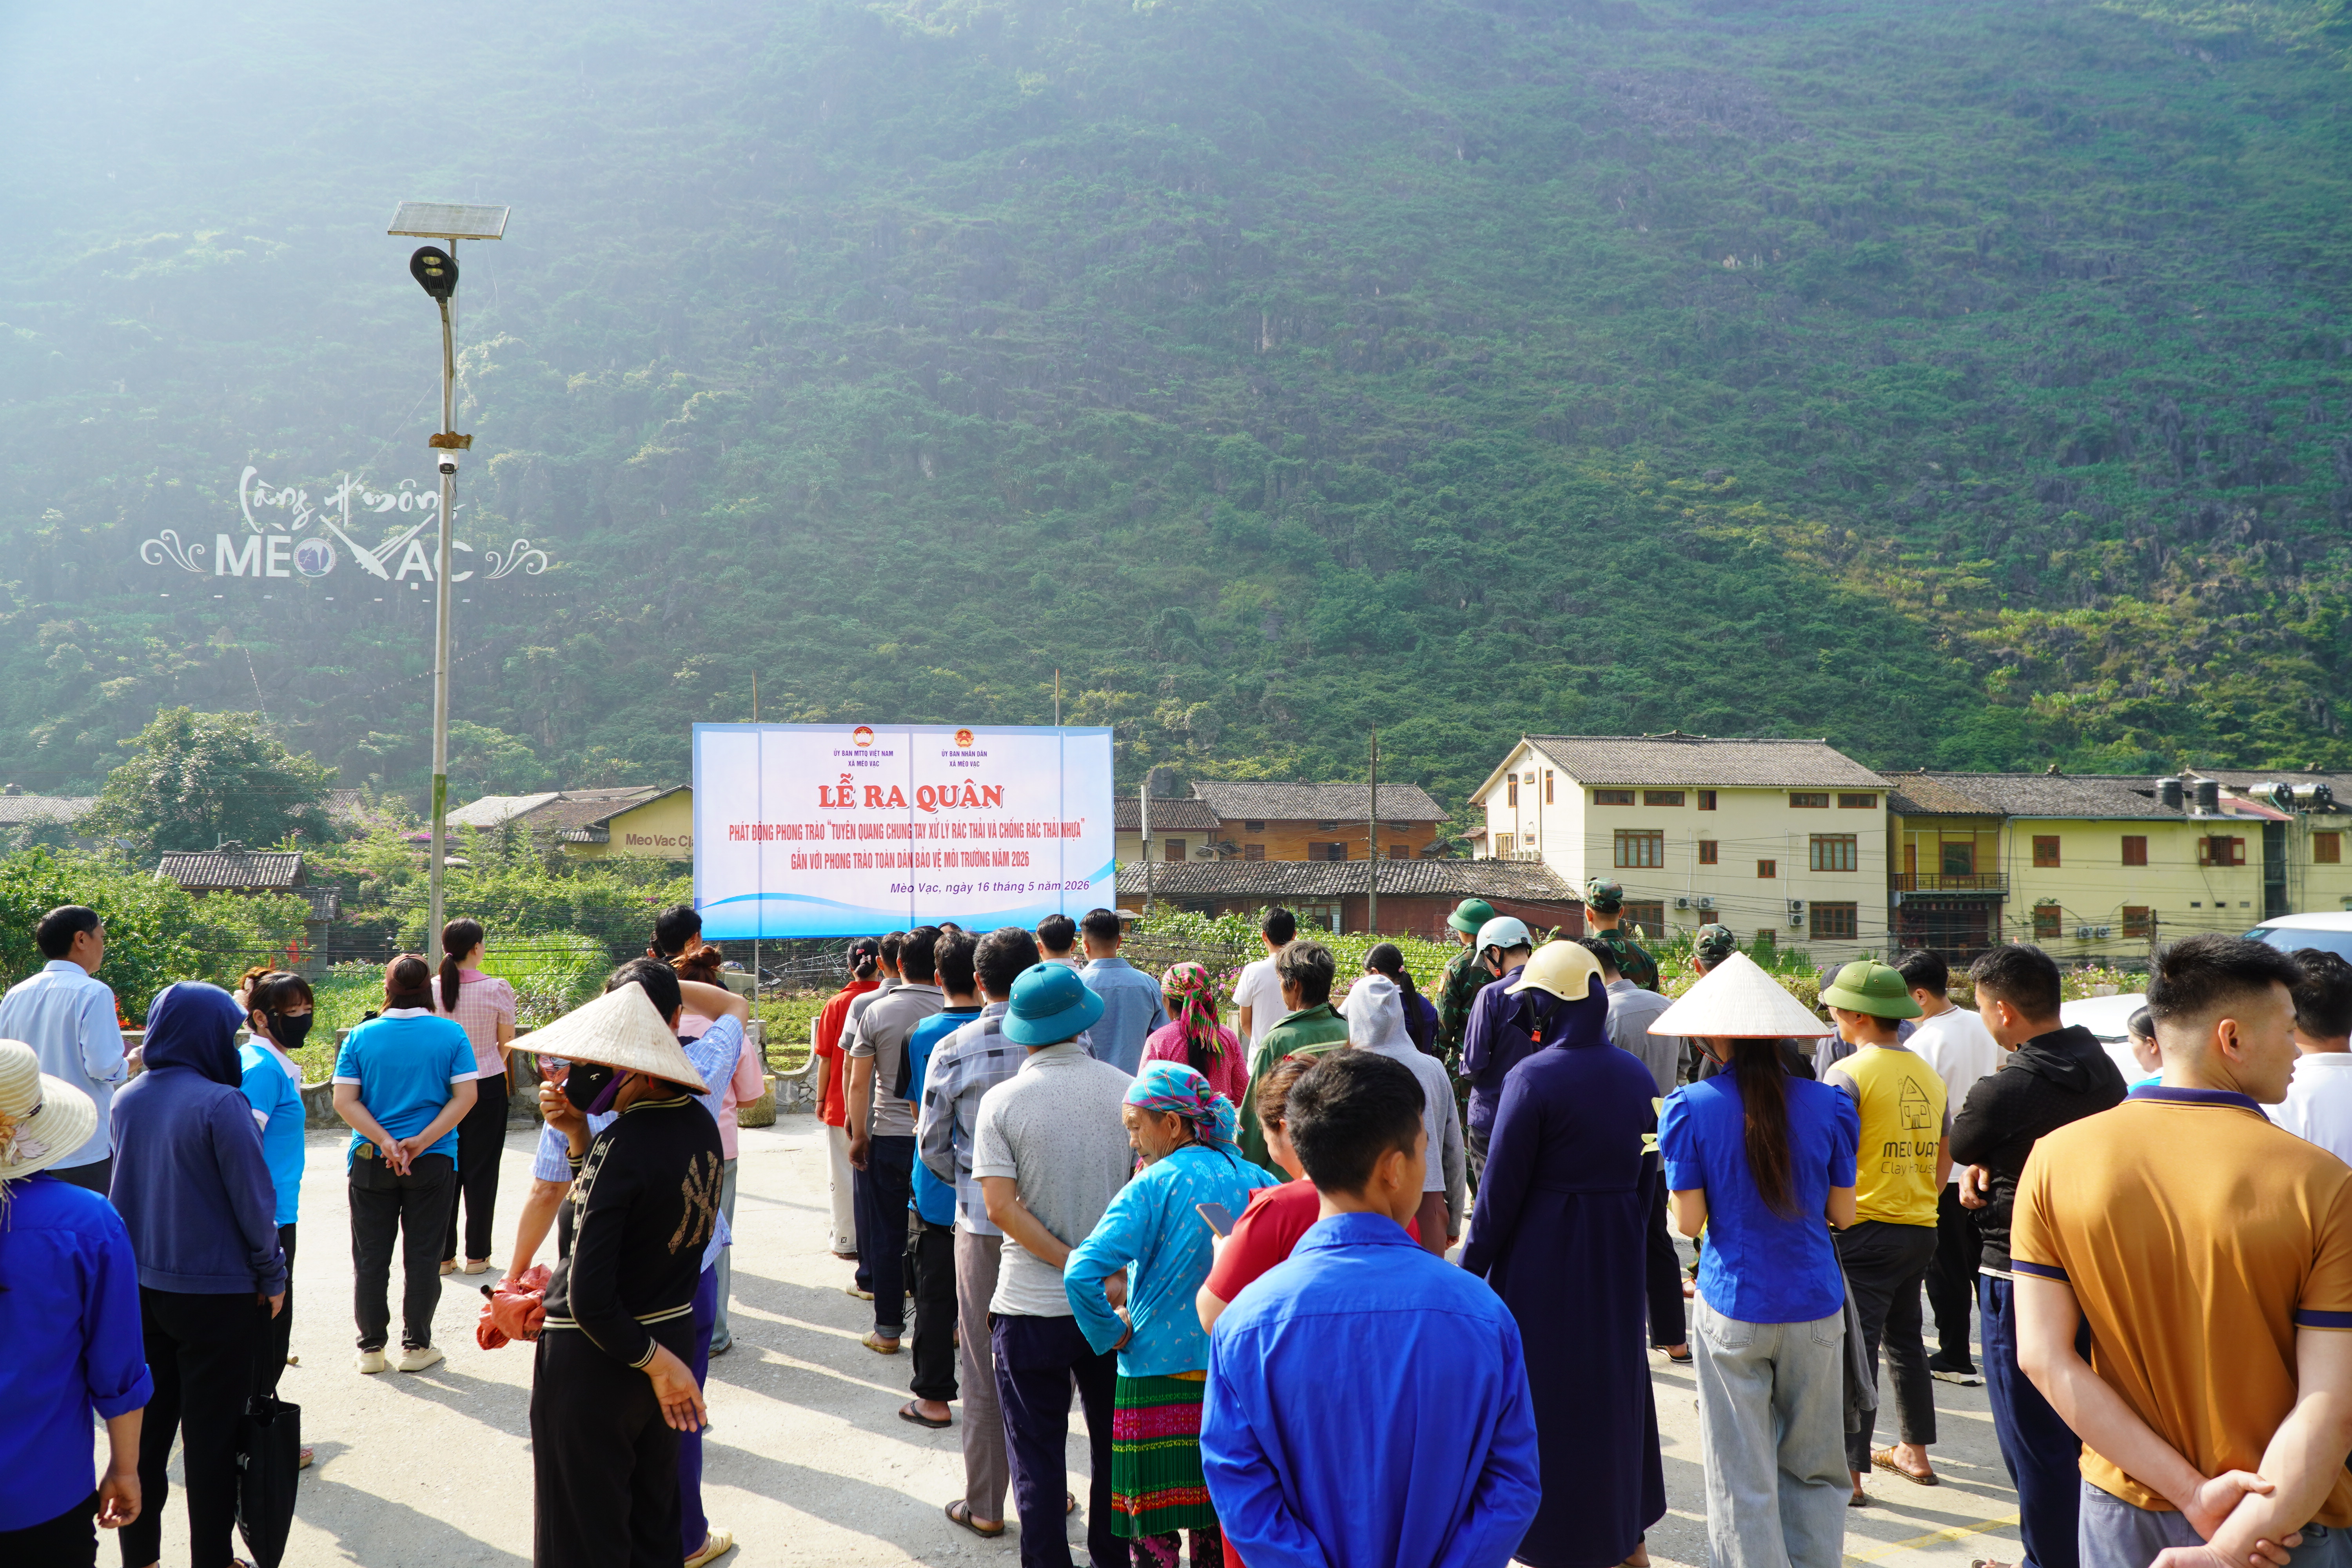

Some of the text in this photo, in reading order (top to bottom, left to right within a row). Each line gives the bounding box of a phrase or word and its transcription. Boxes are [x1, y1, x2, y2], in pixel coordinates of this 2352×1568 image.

[324, 471, 466, 529] H'môn
[869, 750, 880, 758] VIỆT
[818, 773, 1004, 813] LỄ RA QUÂN
[626, 833, 693, 847] Meo Vac Cl
[730, 821, 749, 841] PHÁT
[752, 821, 773, 844] ĐỘNG
[776, 824, 802, 840] PHONG
[805, 820, 825, 840] TRÀO
[858, 823, 884, 841] QUANG
[886, 823, 912, 839] CHUNG
[914, 823, 926, 839] TAY
[929, 817, 939, 839] XỬ
[941, 820, 949, 839] LÝ
[952, 819, 966, 838] RÁC
[969, 817, 985, 838] THẢI
[987, 819, 997, 838] VÀ
[999, 817, 1024, 838] CHỐNG
[1026, 819, 1041, 838] RÁC
[1043, 817, 1058, 838] THẢI
[791, 846, 1029, 871] GẮN VỚI PHONG TRÀO TOÀN DÂN BẢO VỆ MÔI TRƯỜNG NĂM 2026
[890, 880, 1089, 895] Mèo Vạc, ngày 16 tháng 5 năm 2026
[1881, 1161, 1907, 1176] Clay
